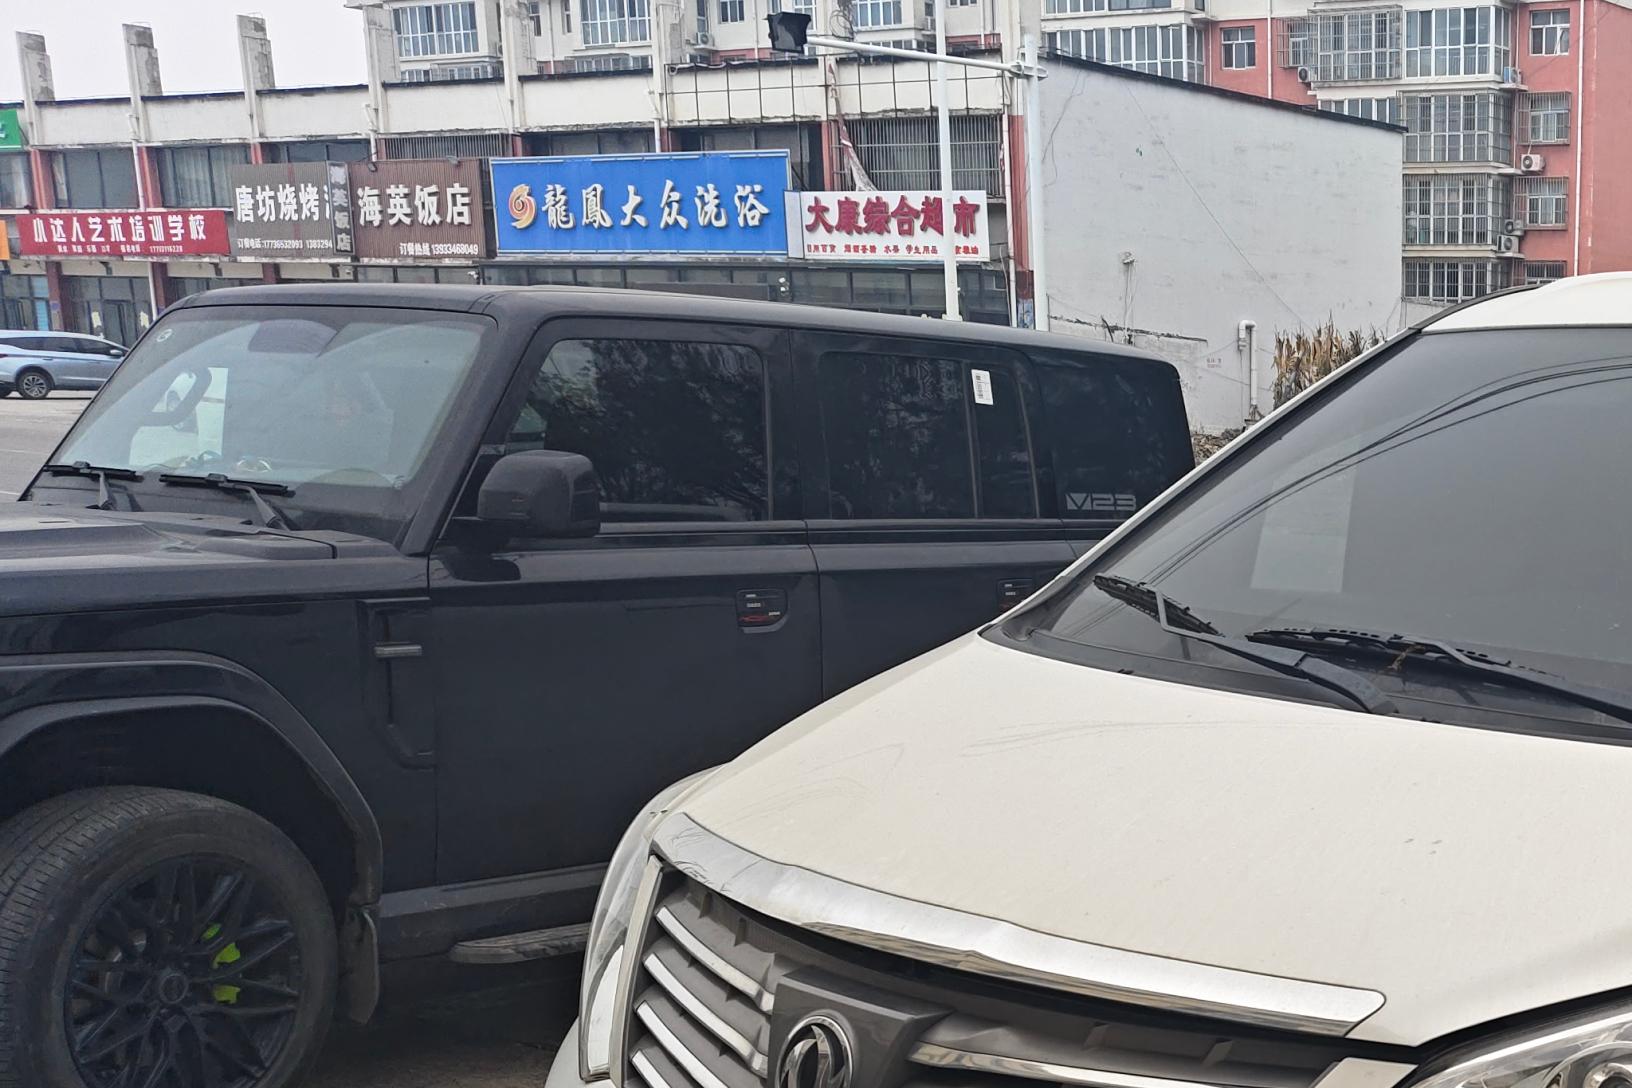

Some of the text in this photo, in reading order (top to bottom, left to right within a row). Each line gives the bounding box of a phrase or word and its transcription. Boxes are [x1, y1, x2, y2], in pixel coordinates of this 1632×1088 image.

[235, 183, 330, 222] 唐坊烧烤
[357, 183, 472, 226] 海英饭店
[542, 179, 770, 230] 龍鳳大众洗浴
[805, 195, 980, 238] 大康综合超市
[33, 214, 206, 242] 小达人艺术培训学校
[306, 239, 333, 249] 1383294
